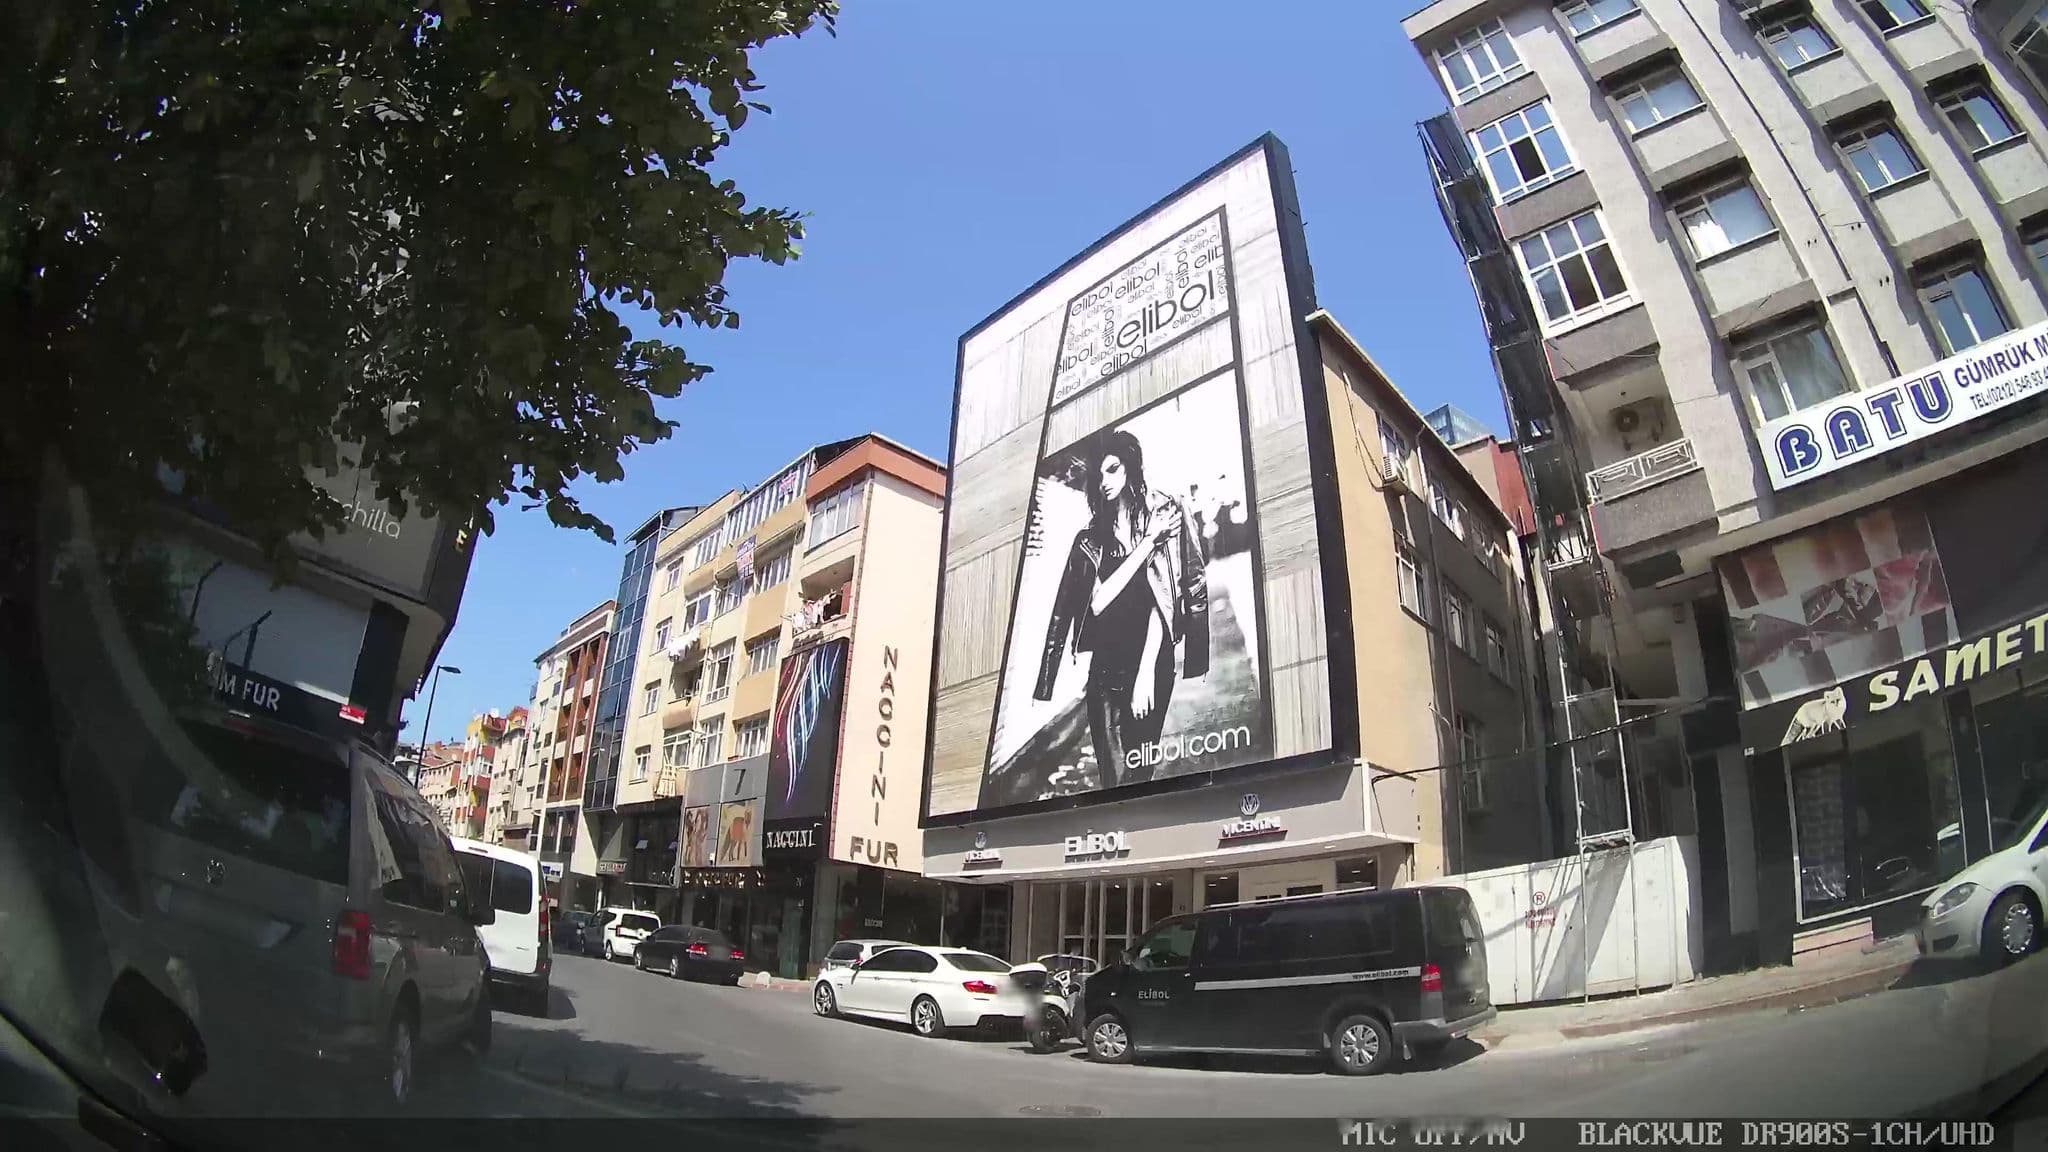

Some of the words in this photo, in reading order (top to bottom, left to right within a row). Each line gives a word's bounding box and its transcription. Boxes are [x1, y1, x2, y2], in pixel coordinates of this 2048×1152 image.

[1115, 261, 1160, 299] elibol
[1174, 248, 1190, 289] elibol
[1071, 281, 1113, 316] elibol
[1116, 269, 1215, 348] elibol
[1102, 307, 1115, 347] elibol
[1100, 338, 1147, 377] elibol
[1775, 371, 1953, 479] BATU
[1954, 341, 2036, 388] GÜMRÜK
[1868, 612, 2048, 712] SAMET
[243, 679, 281, 713] FUR
[1125, 725, 1251, 769] elibol.com
[849, 835, 898, 868] FUR
